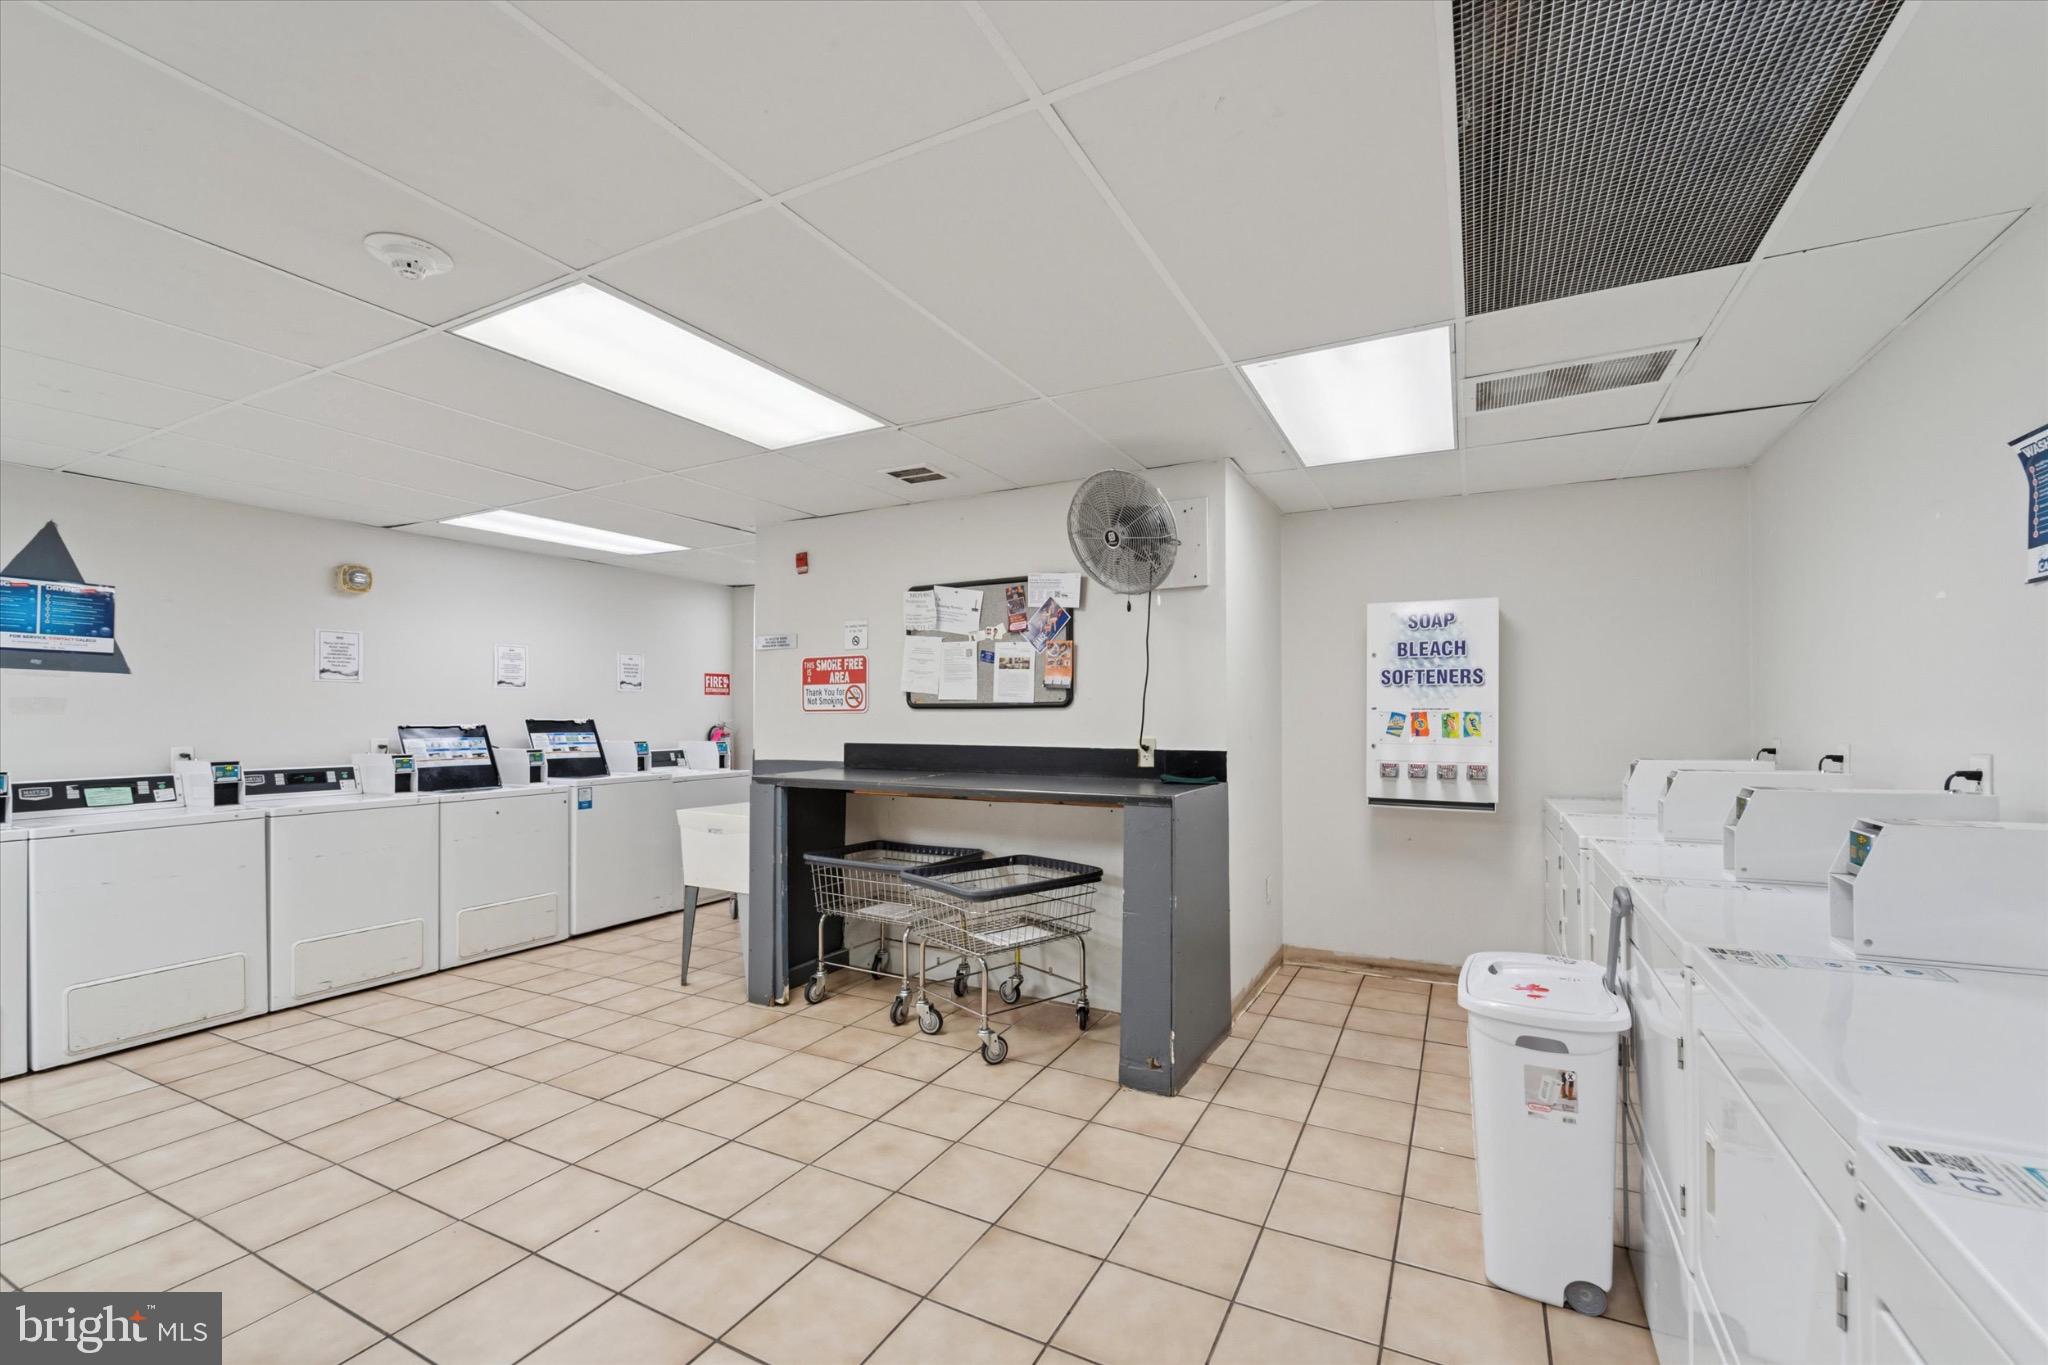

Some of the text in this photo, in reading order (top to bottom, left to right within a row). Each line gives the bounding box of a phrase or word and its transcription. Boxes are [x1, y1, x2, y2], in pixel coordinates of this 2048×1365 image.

[45, 584, 81, 593] DRYING
[1408, 613, 1455, 629] SOAP
[1397, 640, 1466, 657] BLEACH
[804, 661, 815, 669] THIS
[816, 658, 864, 671] SMOKE FREE
[705, 676, 723, 688] FIRE
[829, 671, 850, 684] AREA
[1381, 668, 1485, 685] SOFTENERS
[806, 687, 845, 697] Thank You for
[807, 697, 844, 706] Not Smoking
[1949, 1172, 2003, 1197] 19
